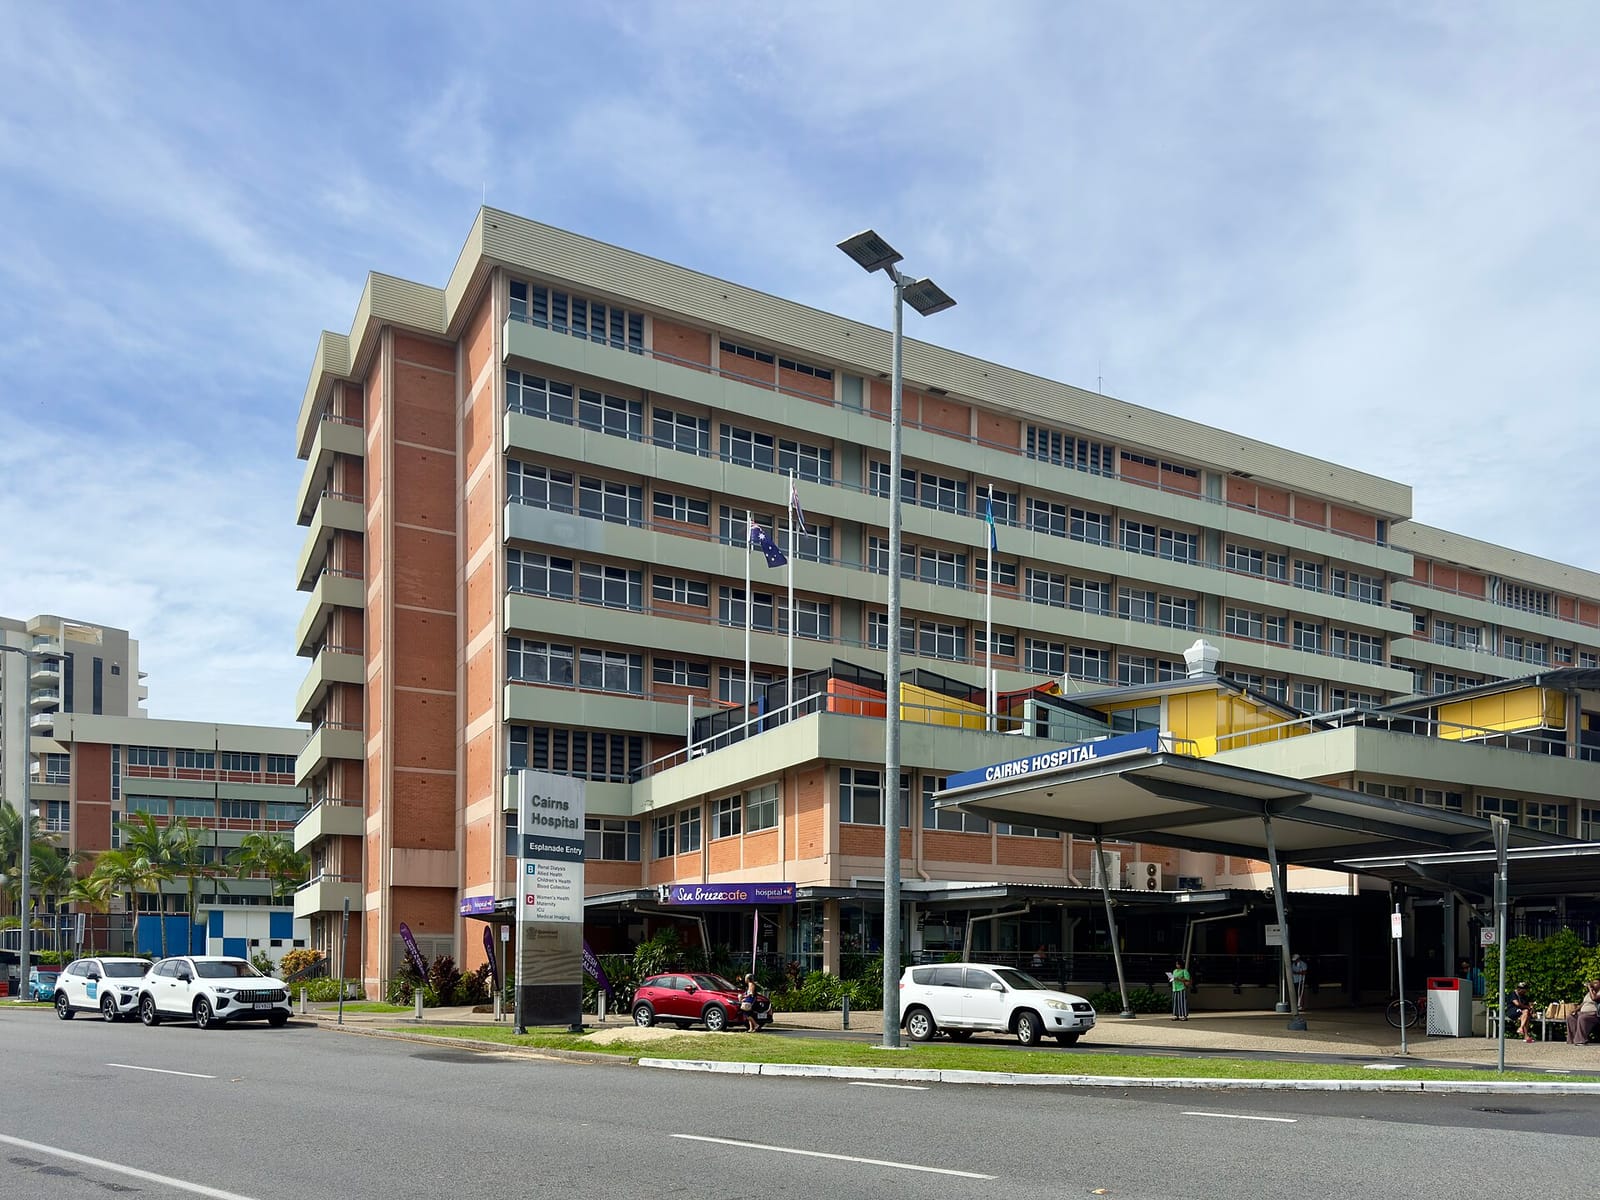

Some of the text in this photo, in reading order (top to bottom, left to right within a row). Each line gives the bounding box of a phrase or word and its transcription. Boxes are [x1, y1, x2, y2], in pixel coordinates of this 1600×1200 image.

[985, 745, 1097, 781] CAIRNS HOSPITAL
[532, 795, 569, 811] Cairns
[531, 812, 579, 830] Hospital
[529, 842, 583, 856] Esplanade Entry
[678, 887, 692, 901] Sea
[755, 888, 783, 899] hospital
[582, 959, 599, 979] ALADS
